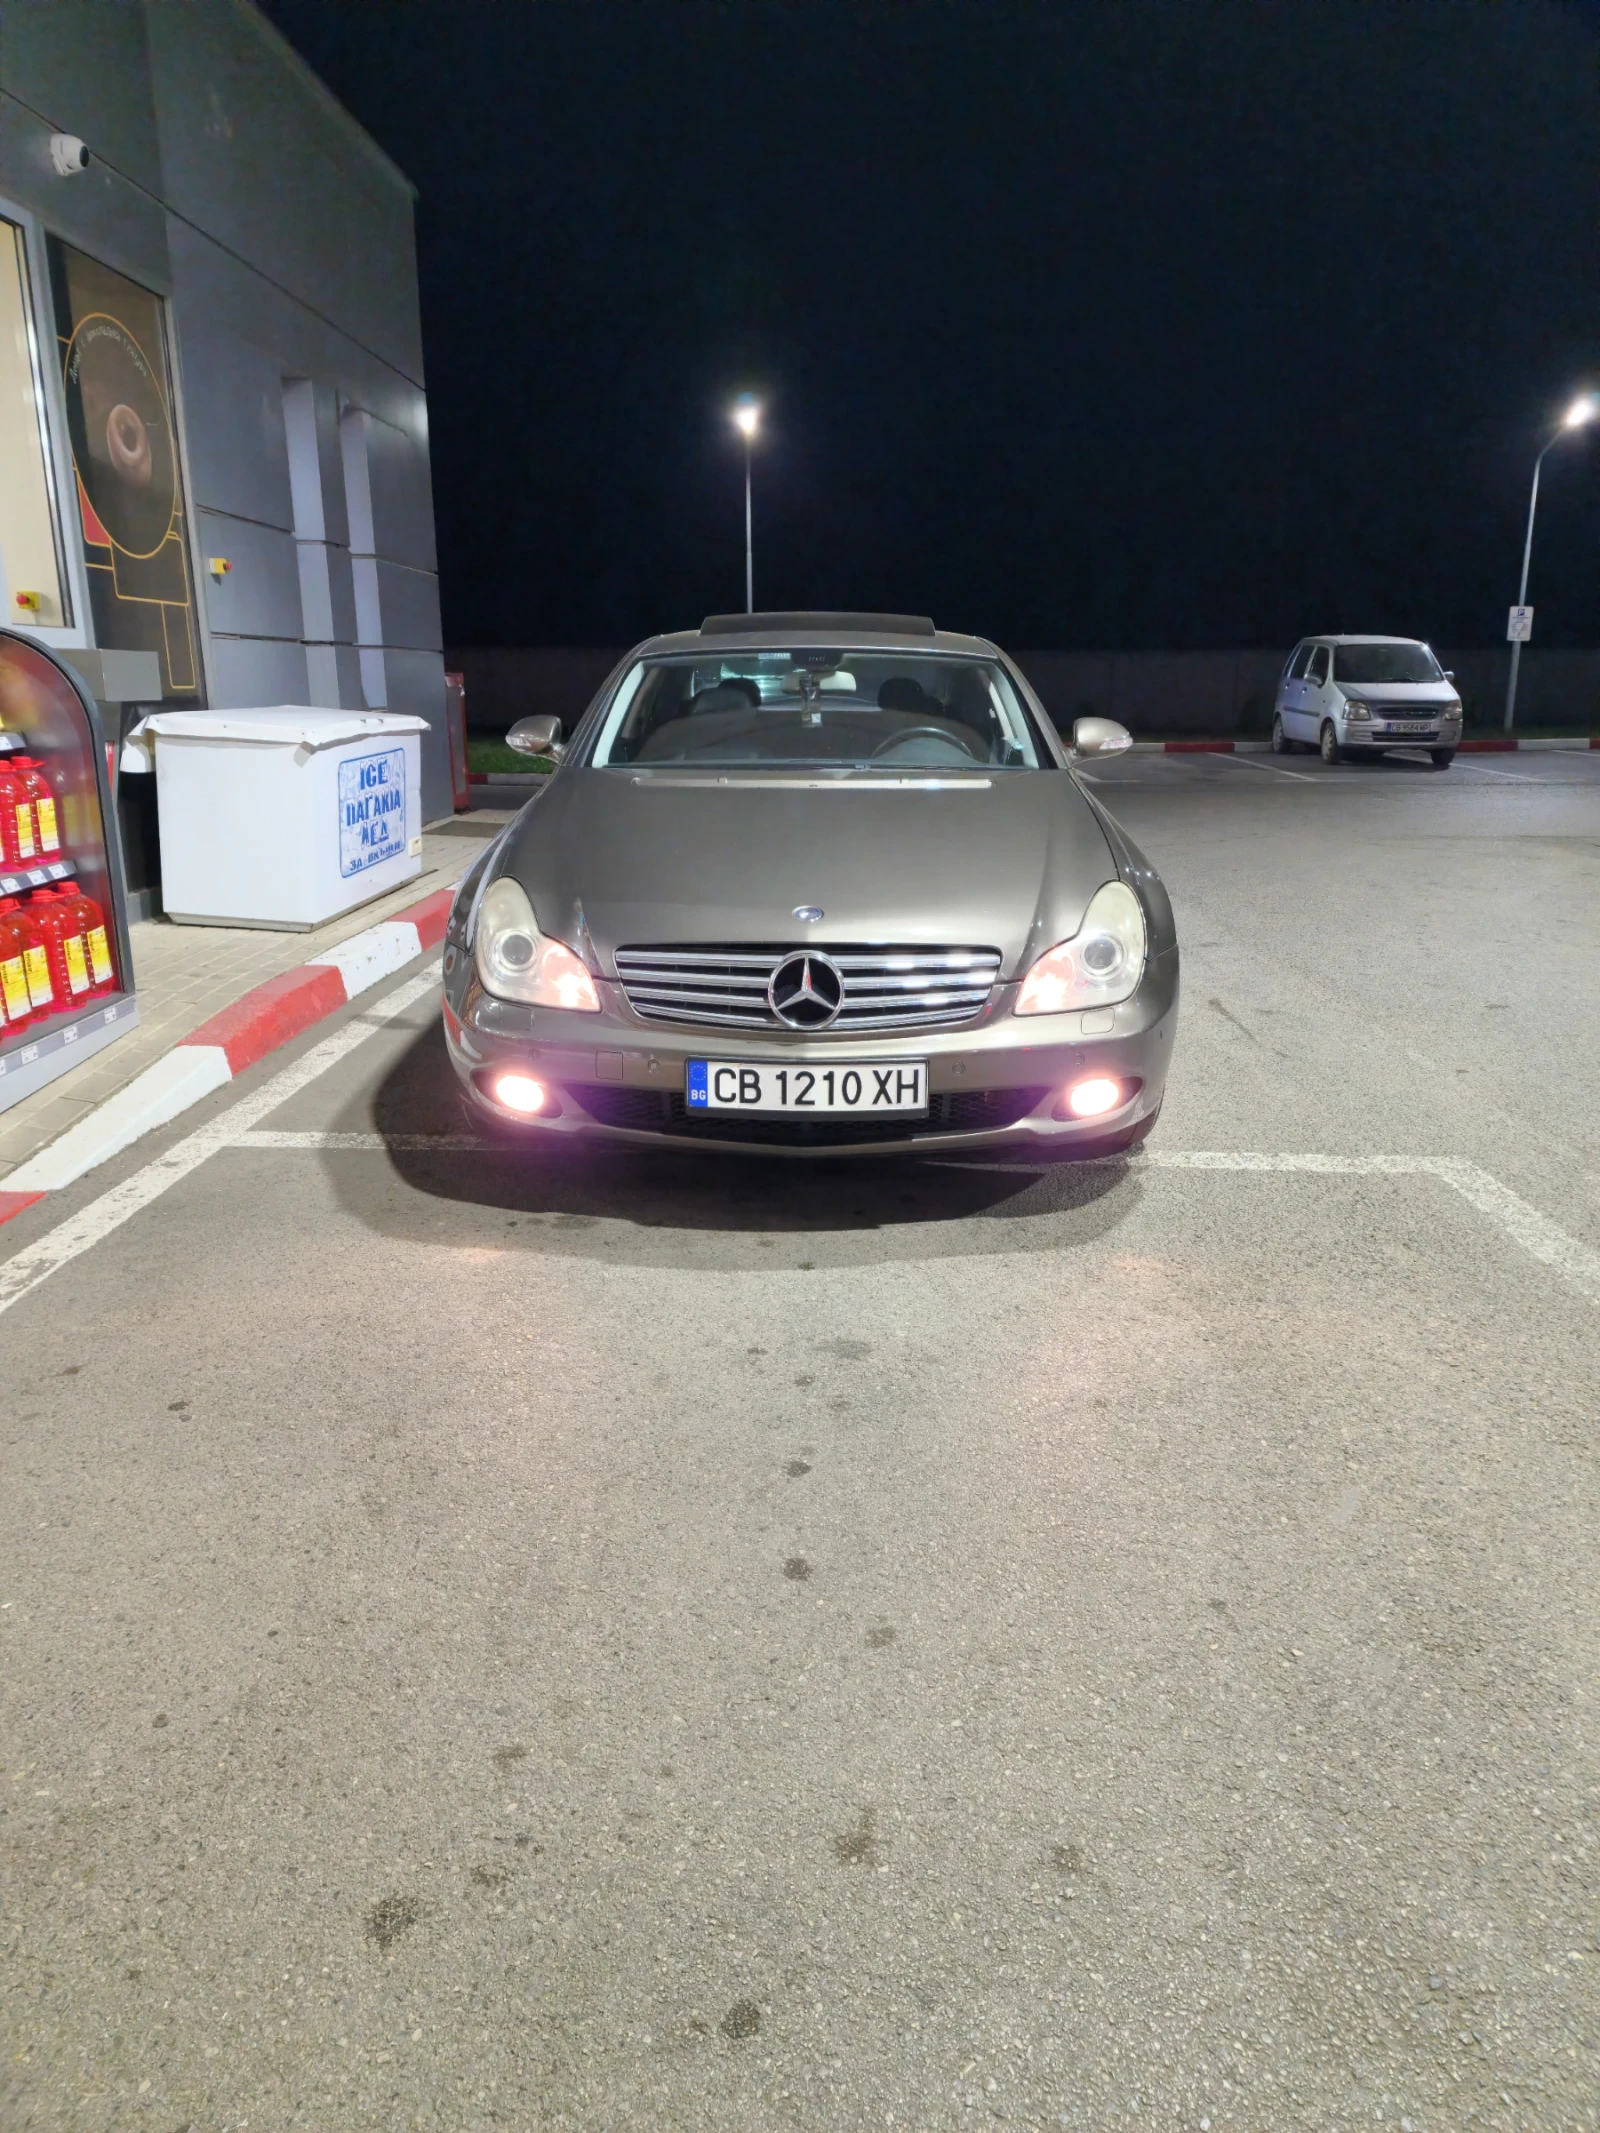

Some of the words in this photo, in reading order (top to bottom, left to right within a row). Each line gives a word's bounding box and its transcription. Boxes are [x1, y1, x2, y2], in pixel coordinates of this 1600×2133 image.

[360, 758, 388, 790] ICE
[349, 858, 363, 872] ЗА
[691, 1089, 706, 1100] BG
[714, 1068, 762, 1104] CB
[776, 1070, 862, 1106] 1210
[872, 1069, 920, 1105] XH
